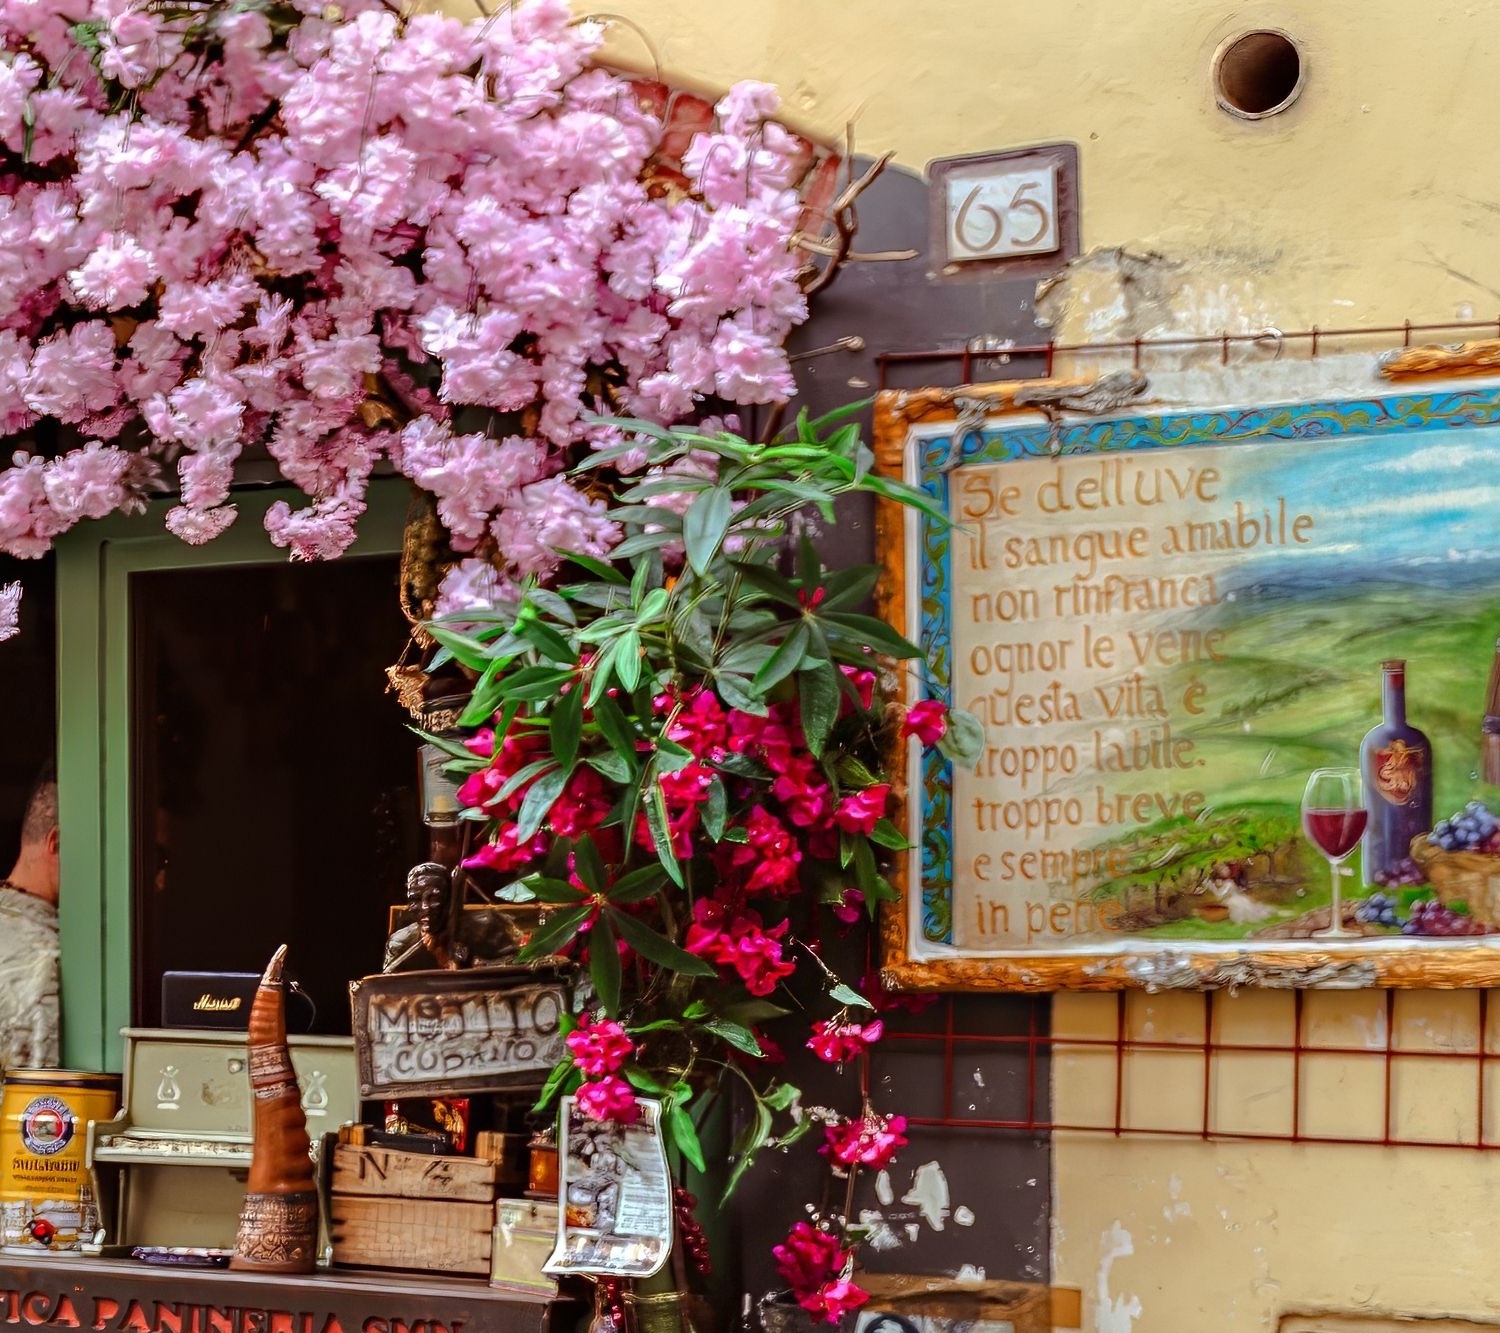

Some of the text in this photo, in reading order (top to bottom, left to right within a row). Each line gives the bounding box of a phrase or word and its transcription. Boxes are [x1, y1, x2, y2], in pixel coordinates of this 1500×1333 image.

[955, 182, 1049, 253] 65
[961, 472, 1021, 518] Se
[970, 497, 1314, 581] il sangue amabile
[971, 574, 1223, 623] non rinfranca
[970, 625, 1229, 696] ognor le vene
[1095, 672, 1169, 720] vita
[972, 786, 1206, 842] troppo breve
[972, 849, 1129, 890] e sempre
[976, 894, 1124, 945] in pene
